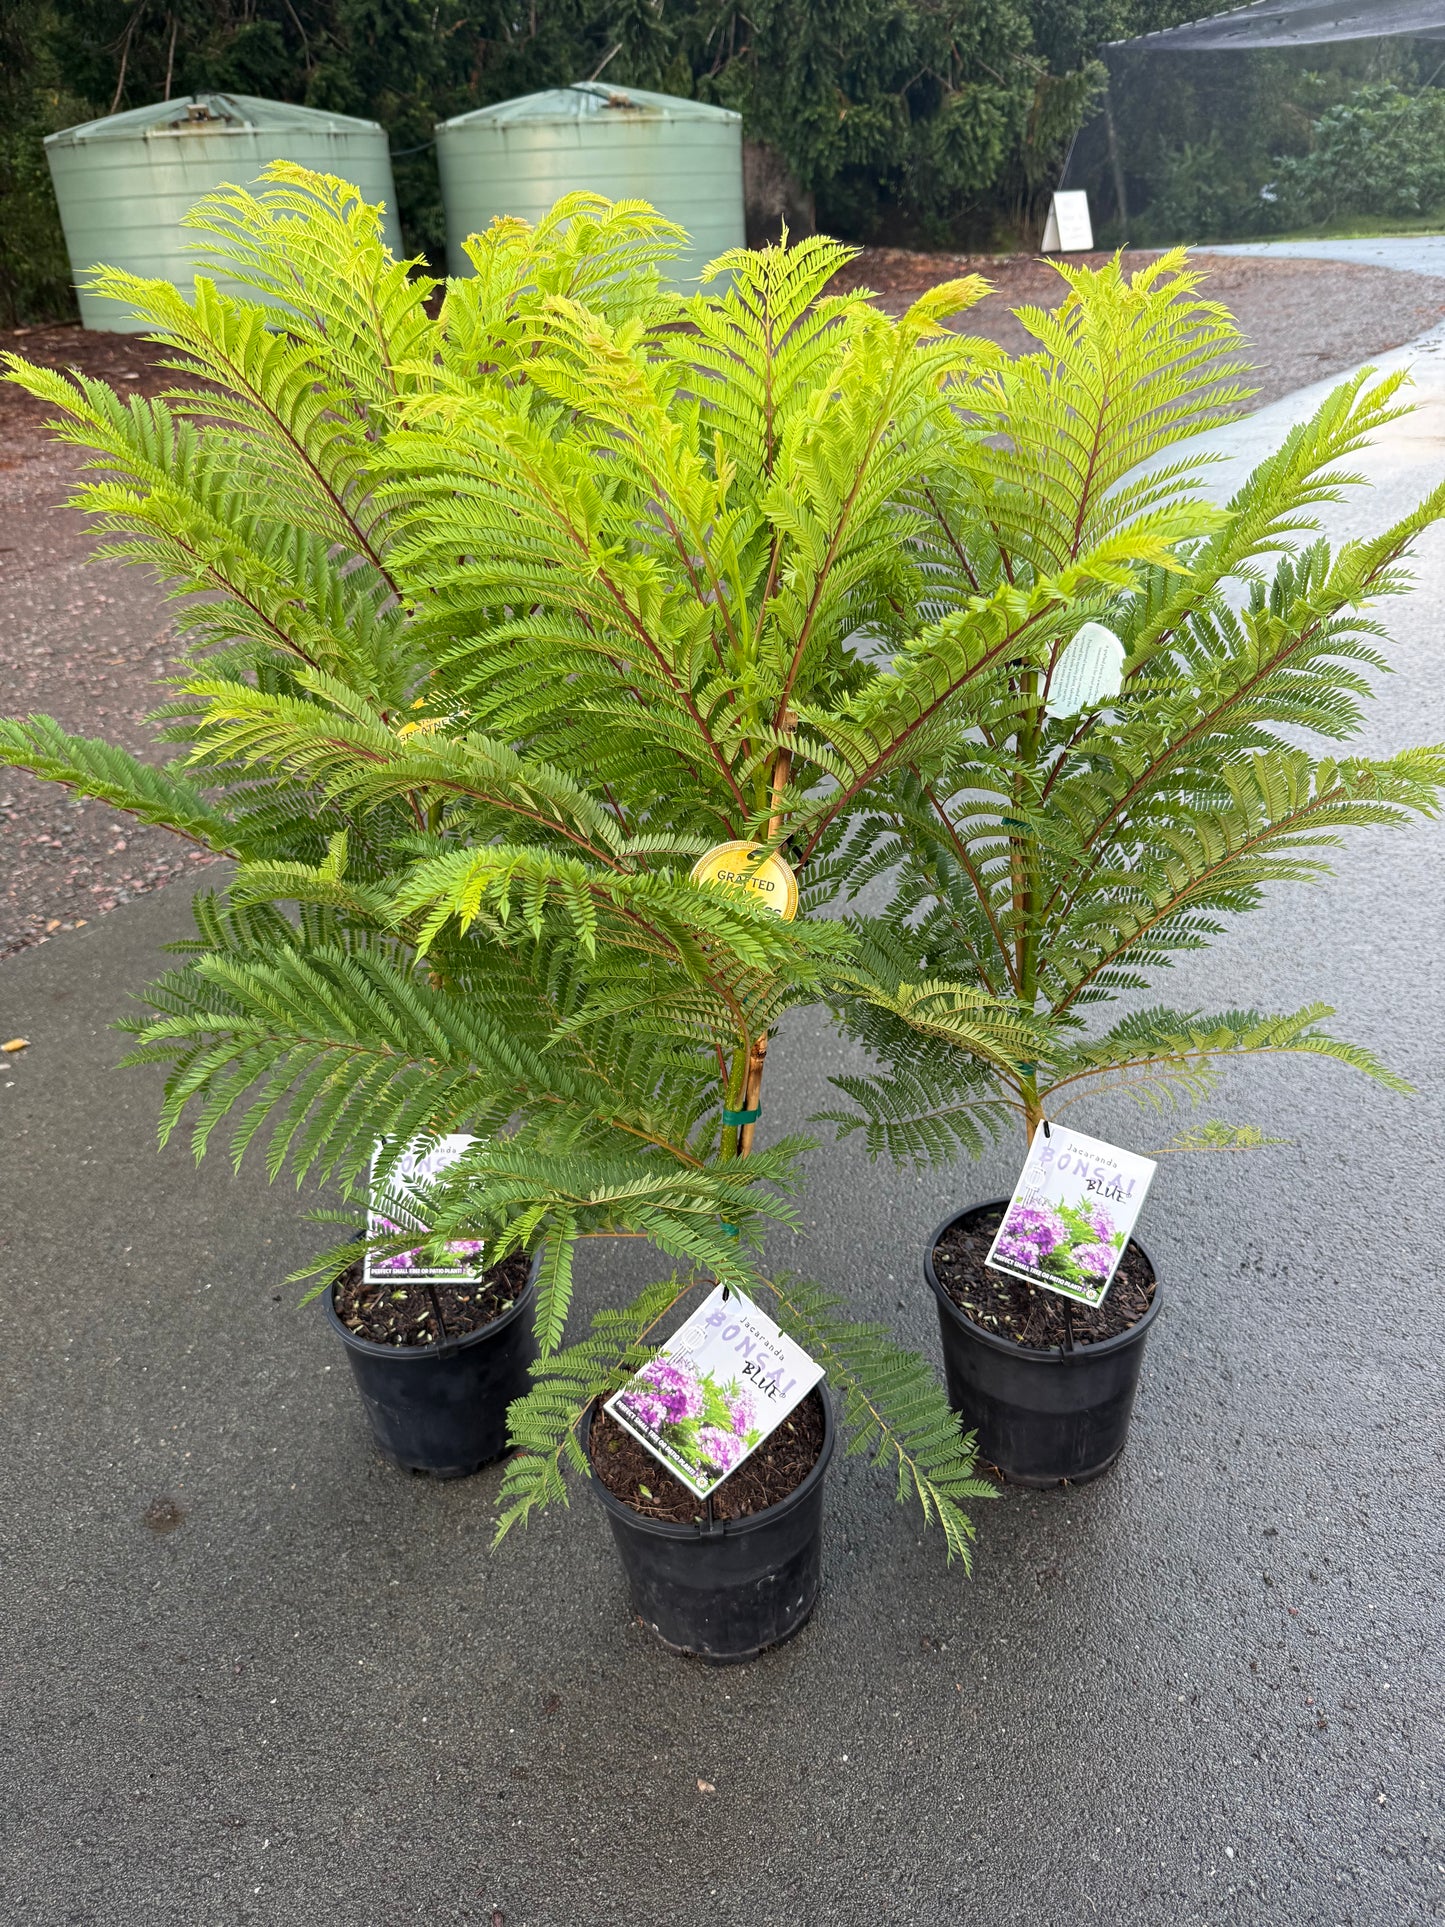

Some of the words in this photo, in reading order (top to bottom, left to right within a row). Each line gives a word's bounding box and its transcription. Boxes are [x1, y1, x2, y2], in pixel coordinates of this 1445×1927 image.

[717, 870, 775, 892] GRATED
[1039, 1146, 1136, 1194] BONSAI
[1067, 1144, 1118, 1168] Jacaranda
[994, 1253, 1014, 1265] PERFECT
[1014, 1260, 1030, 1272] SMALL
[1030, 1266, 1042, 1276] TREE
[1041, 1271, 1050, 1279] OR
[1049, 1274, 1064, 1284] PATIO
[706, 1308, 796, 1393] BONSAI
[739, 1316, 785, 1361] Jacaranda
[615, 1400, 636, 1419] PERFECT
[634, 1416, 650, 1433] SMALL
[648, 1429, 661, 1443] TREE
[658, 1439, 668, 1450] OR
[665, 1446, 681, 1461] PATIO
[679, 1457, 698, 1477] PLANT!
